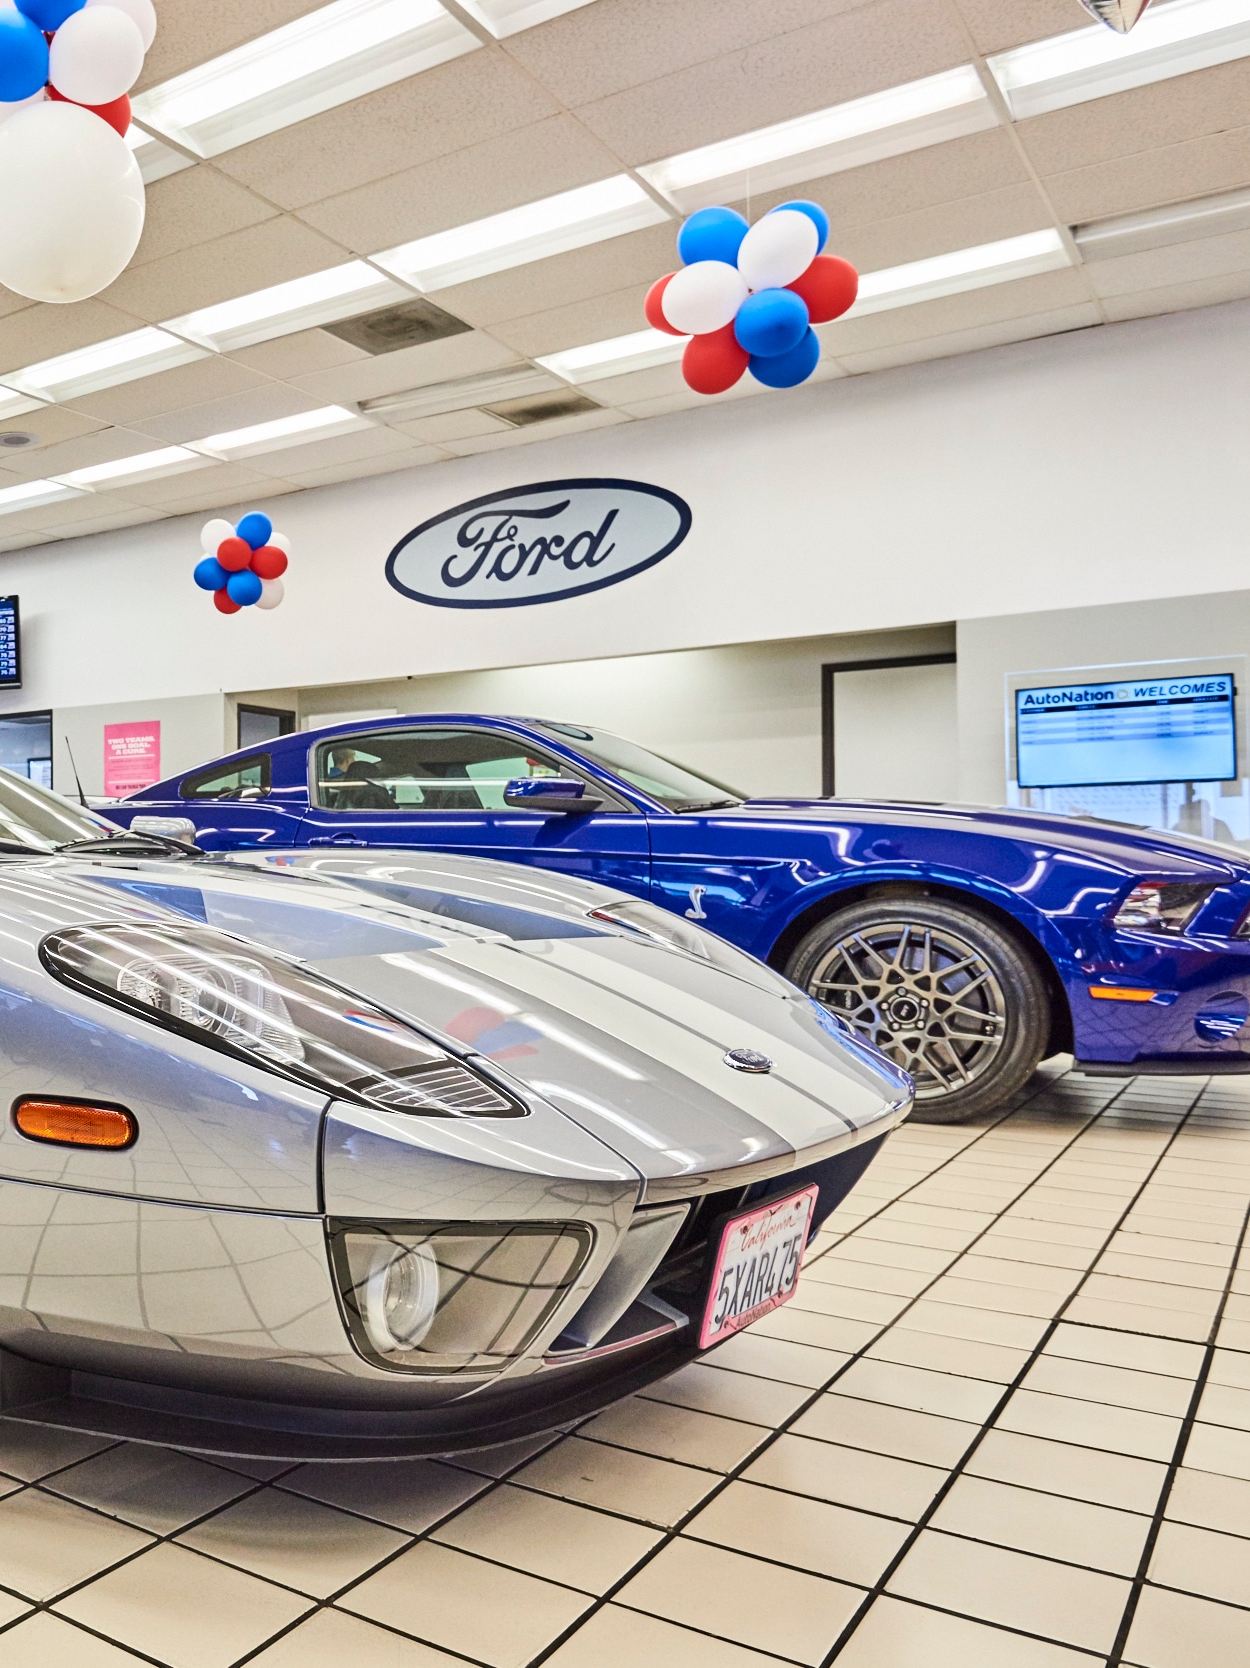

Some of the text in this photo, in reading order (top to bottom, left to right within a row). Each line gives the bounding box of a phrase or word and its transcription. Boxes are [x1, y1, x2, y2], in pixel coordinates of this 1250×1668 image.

[440, 499, 620, 588] Ford
[1023, 681, 1227, 706] AutoNation WELCOMES
[740, 1213, 796, 1252] California
[714, 1233, 803, 1325] 5XAR475
